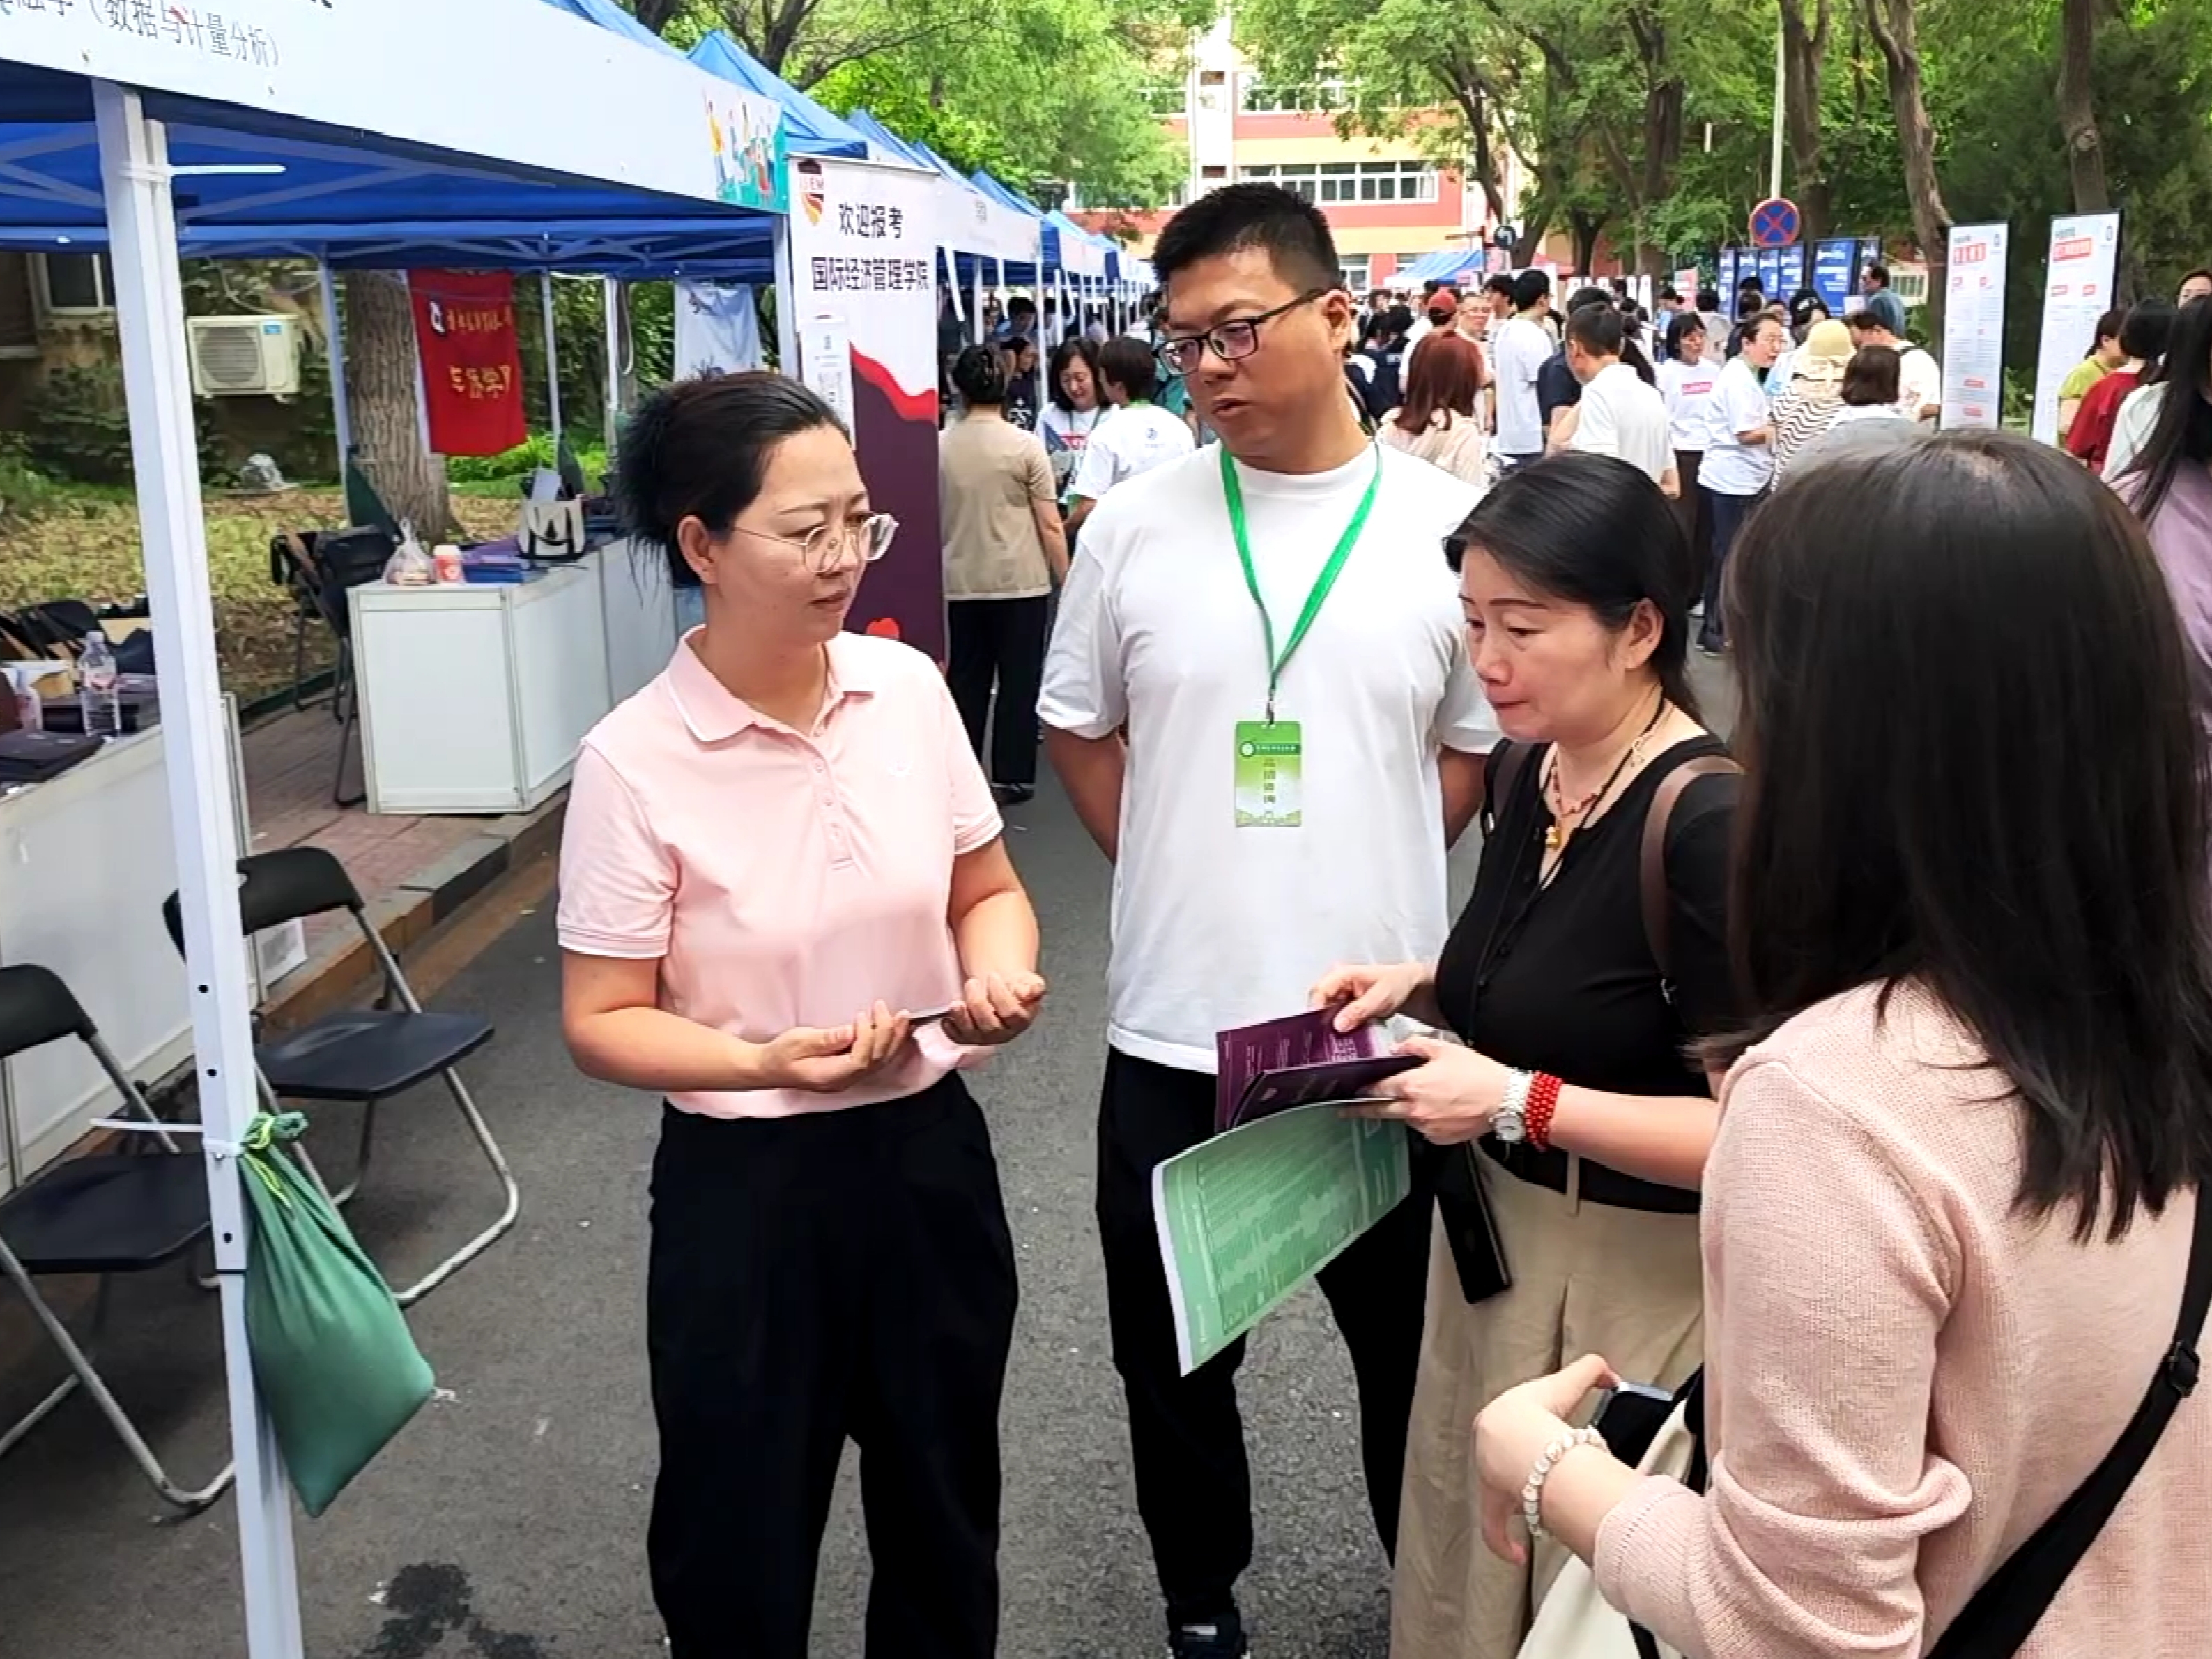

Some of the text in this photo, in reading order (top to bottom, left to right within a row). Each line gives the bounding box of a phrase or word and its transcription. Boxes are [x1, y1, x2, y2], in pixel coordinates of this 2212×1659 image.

[838, 202, 903, 238] 欢迎报考
[811, 257, 930, 292] 国际经济管理学院
